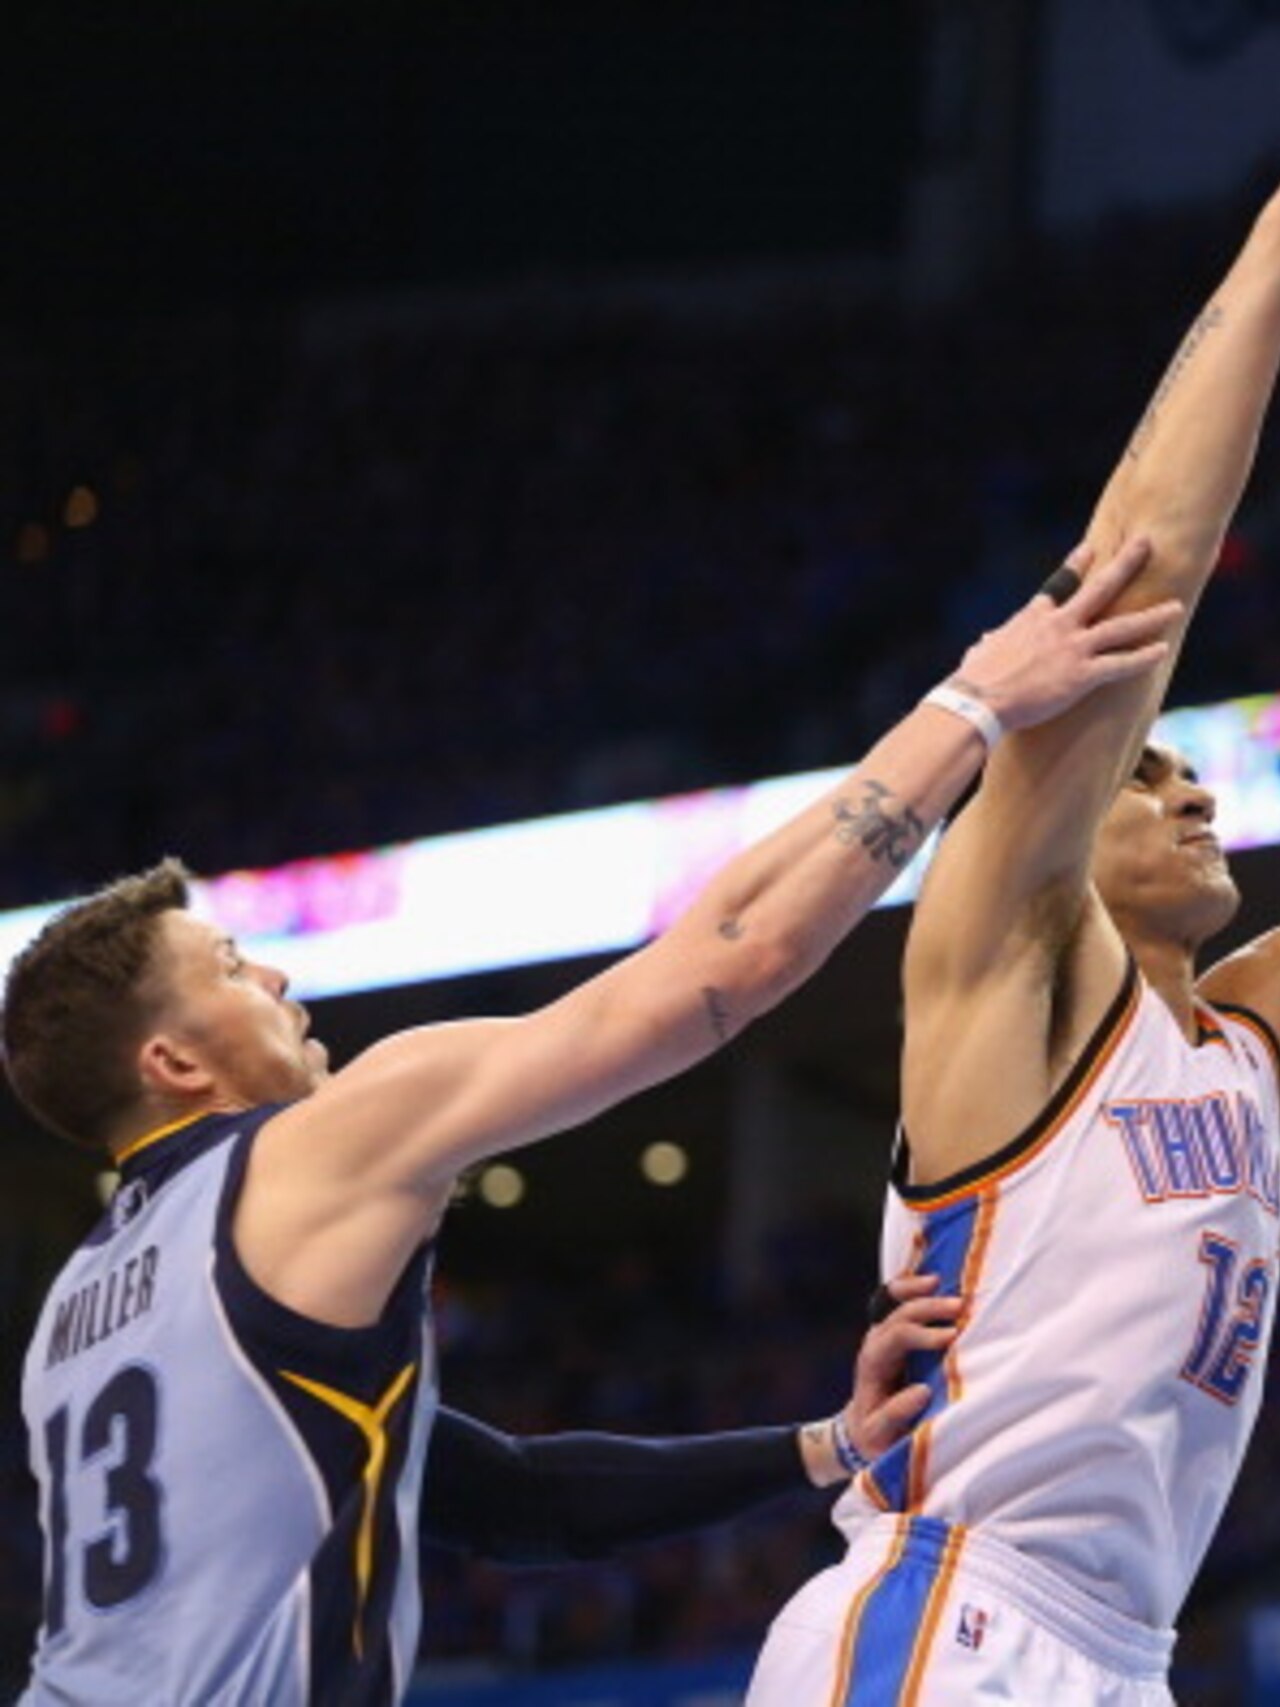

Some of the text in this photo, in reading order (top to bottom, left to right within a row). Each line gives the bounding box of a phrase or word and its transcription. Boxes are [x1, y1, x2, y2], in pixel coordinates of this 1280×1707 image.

[44, 1245, 160, 1370] MILLER
[1178, 1231, 1270, 1407] 12
[44, 1364, 166, 1642] 13
